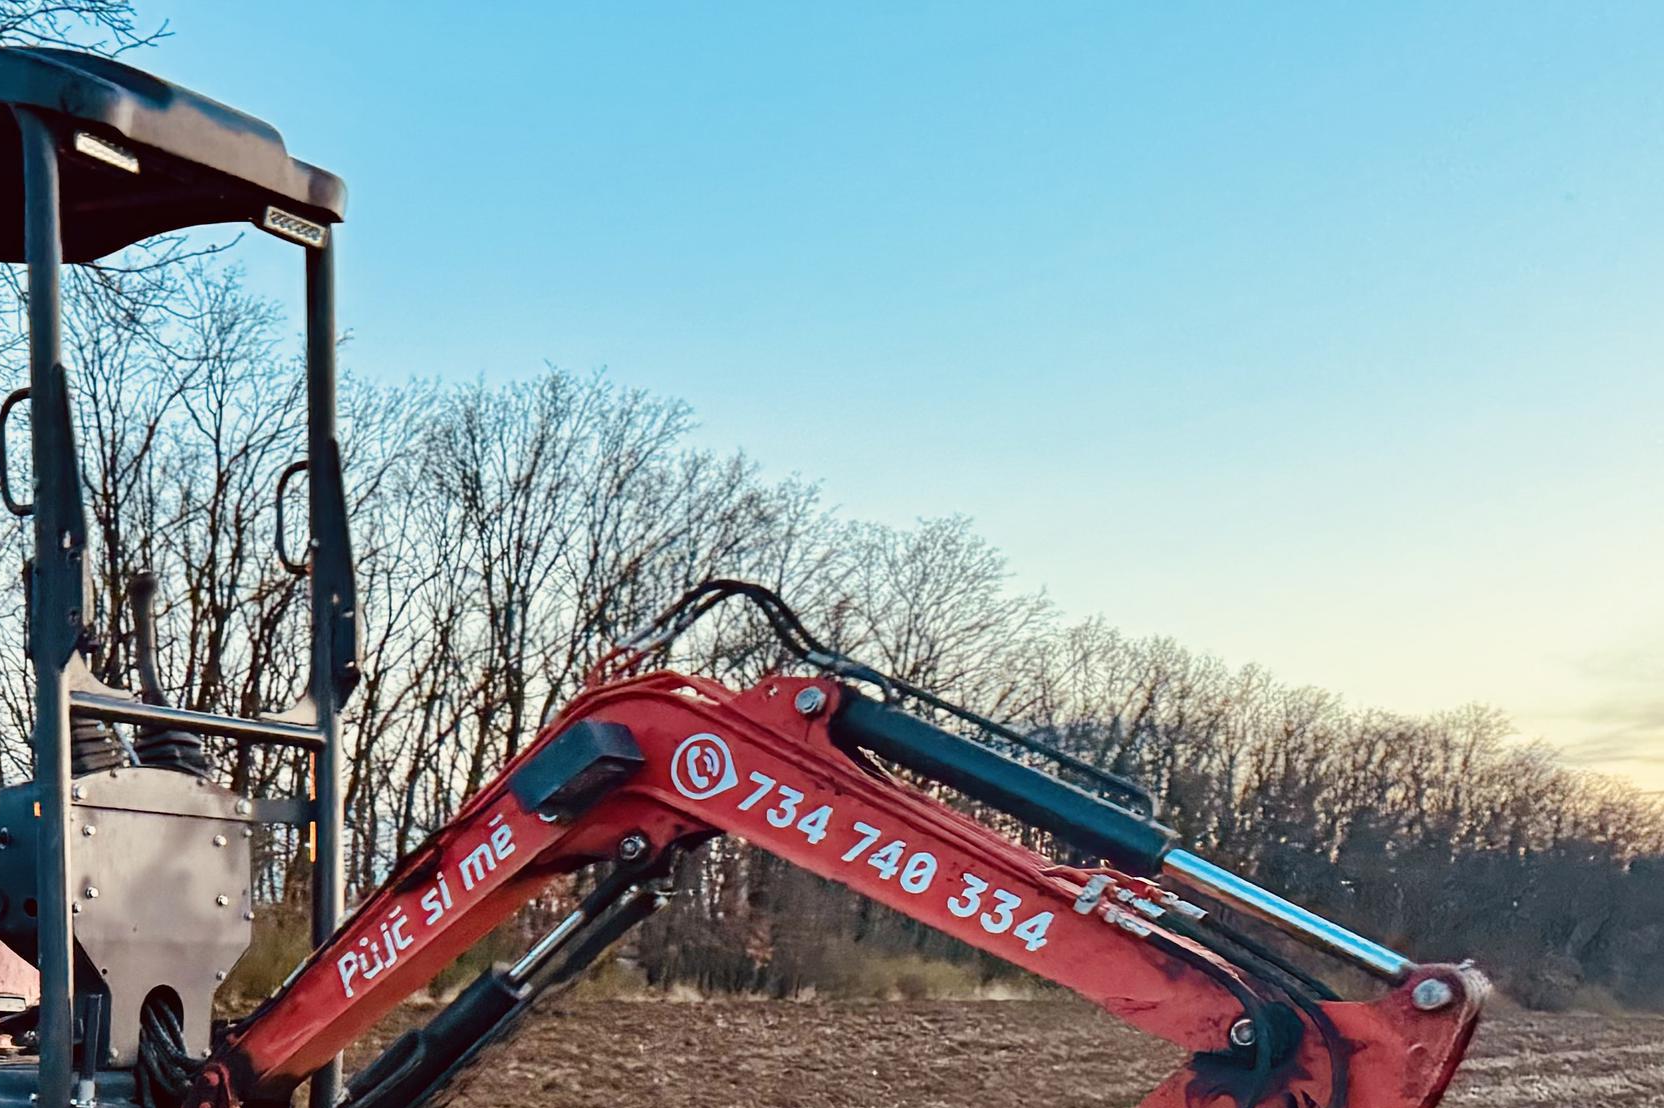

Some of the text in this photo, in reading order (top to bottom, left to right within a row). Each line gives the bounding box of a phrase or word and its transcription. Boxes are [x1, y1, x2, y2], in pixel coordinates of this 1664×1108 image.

[737, 770, 1055, 951] 734 740 334
